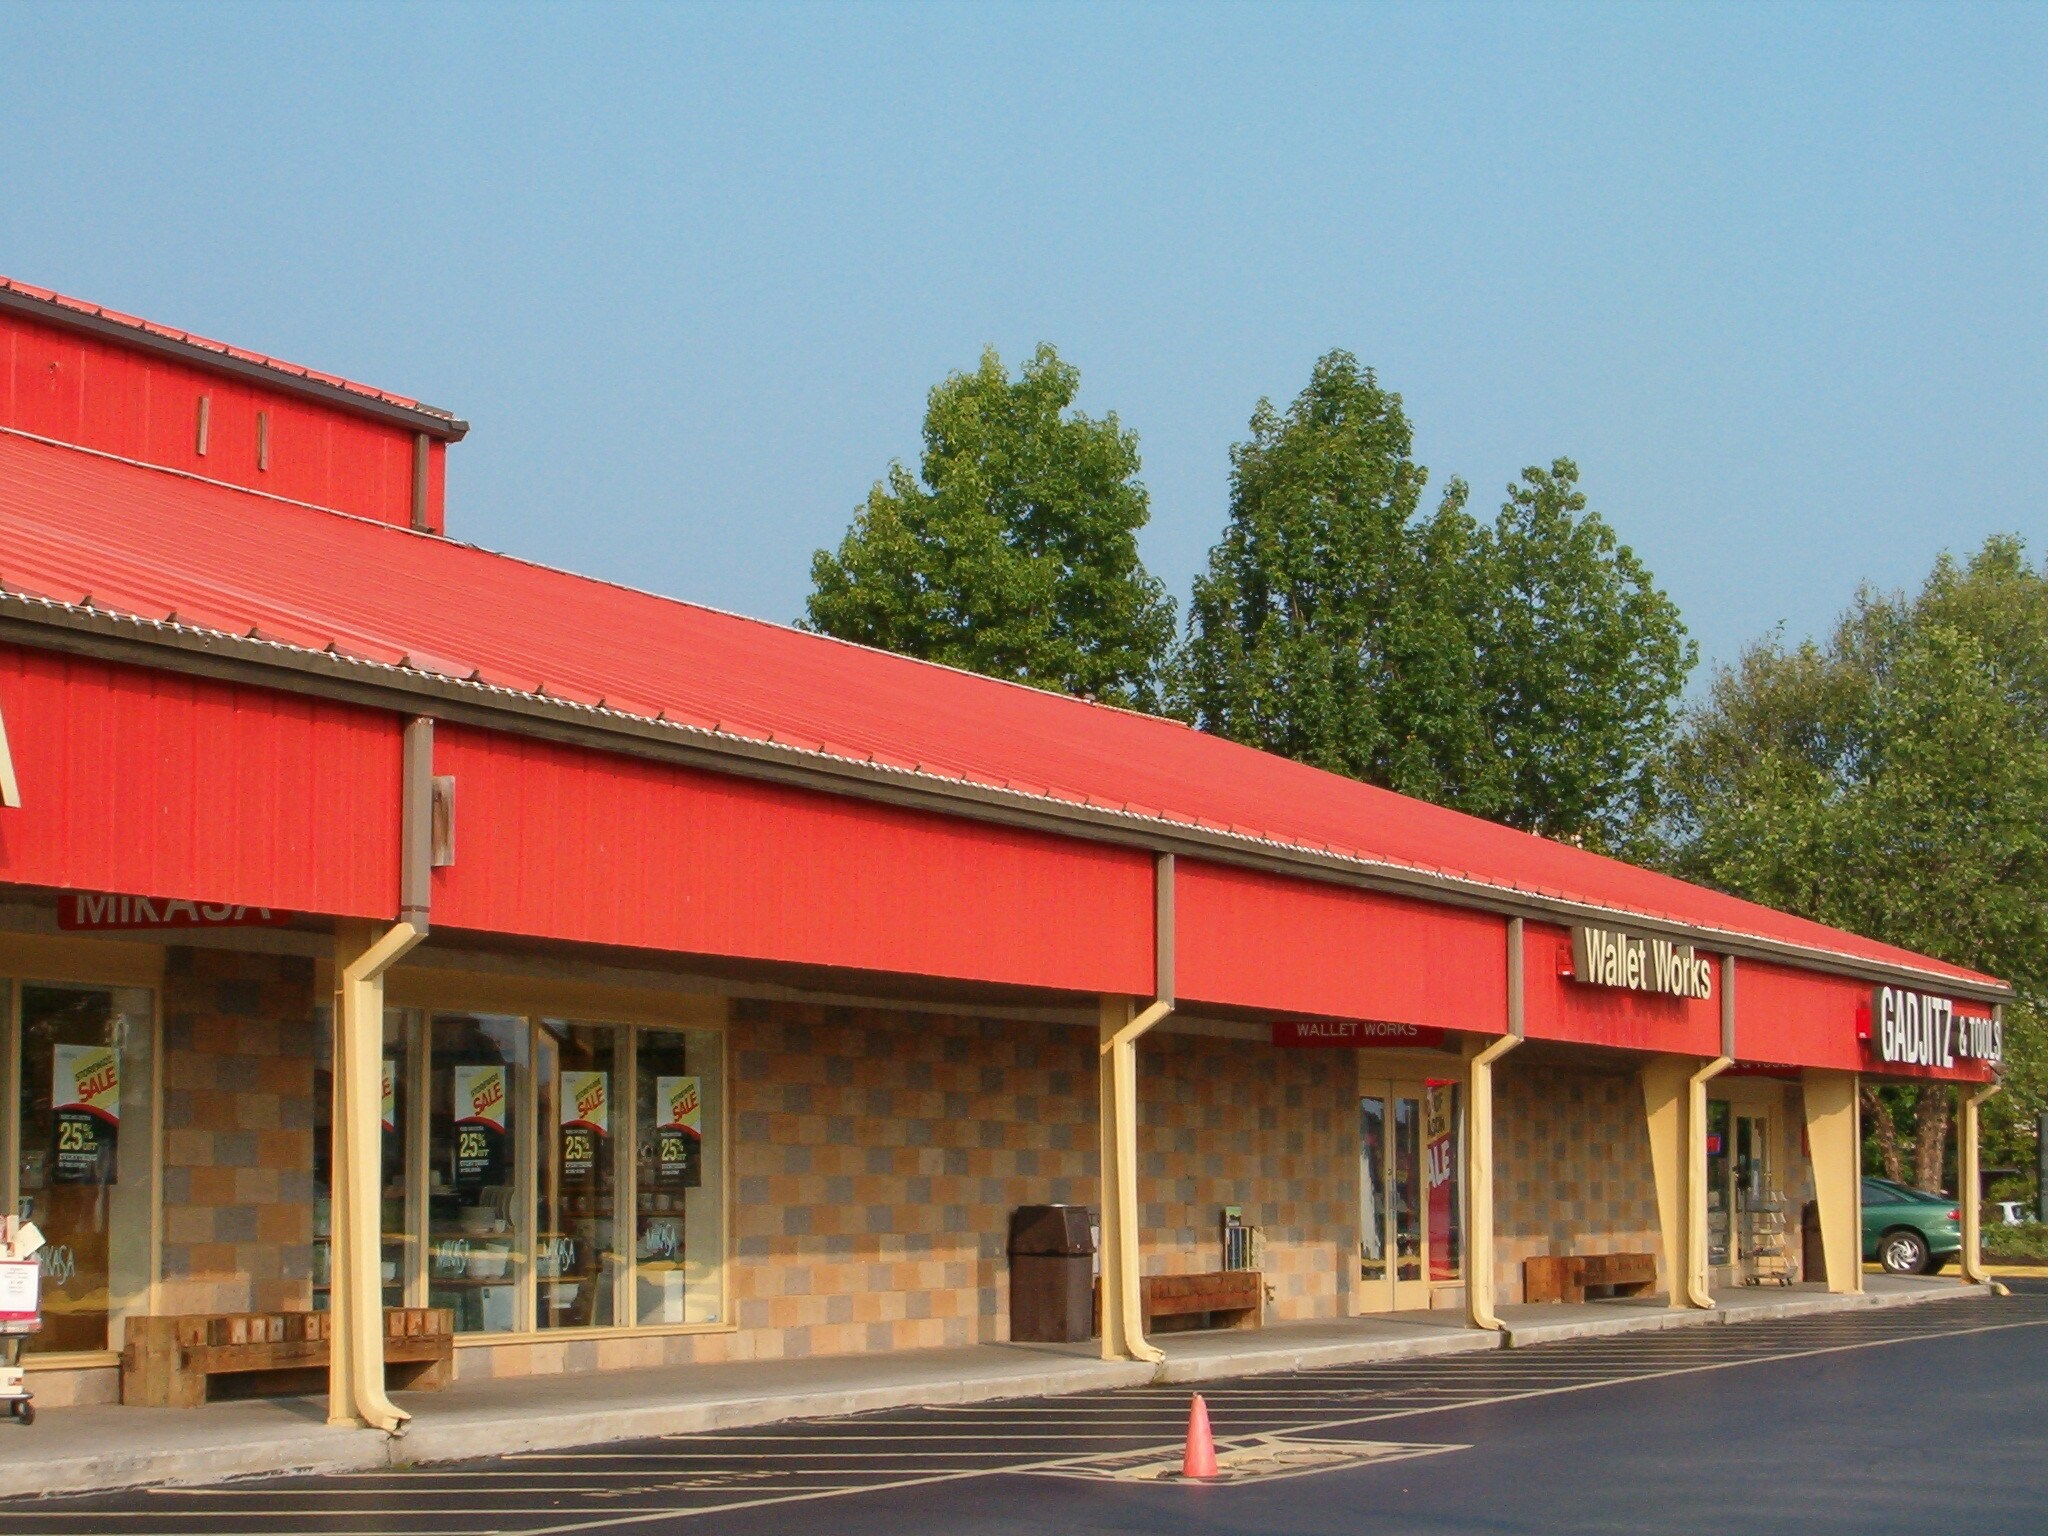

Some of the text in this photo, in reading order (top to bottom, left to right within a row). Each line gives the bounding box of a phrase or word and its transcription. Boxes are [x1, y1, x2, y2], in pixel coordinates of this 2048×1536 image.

[1584, 927, 1711, 1000] Wallet Works
[1296, 1023, 1418, 1036] WALLET WORKS
[1881, 986, 2001, 1068] GADJITZ & TOOLS
[78, 1066, 118, 1103] SALE
[473, 1081, 503, 1116] SALE
[578, 1087, 605, 1119] SALE
[672, 1091, 699, 1123] SALE
[59, 1121, 94, 1150] 25%
[459, 1132, 486, 1158] 25%
[565, 1135, 590, 1160] 25%
[661, 1138, 684, 1161] 25%
[1428, 1140, 1451, 1188] ALE
